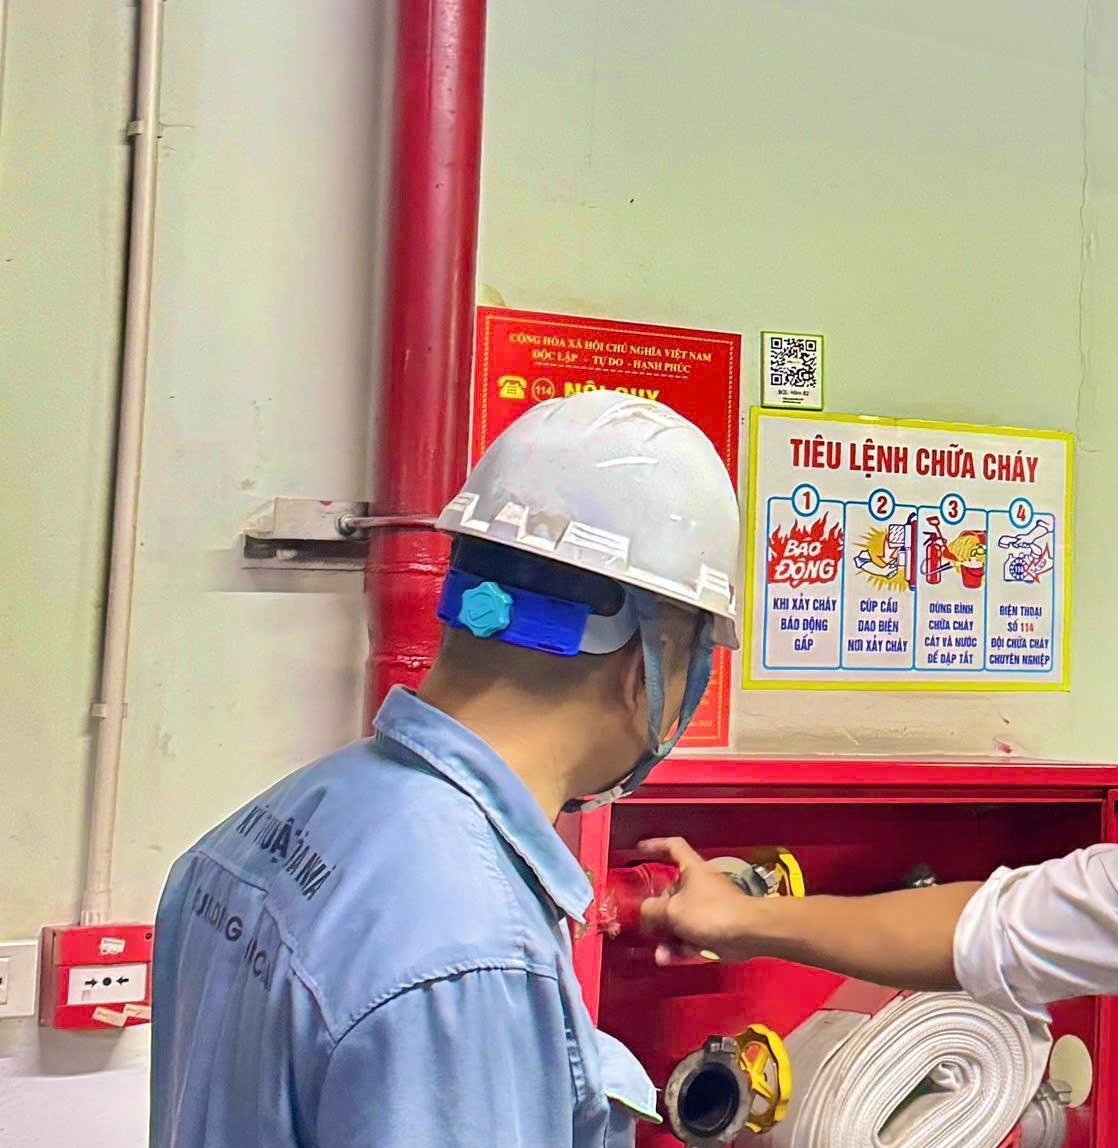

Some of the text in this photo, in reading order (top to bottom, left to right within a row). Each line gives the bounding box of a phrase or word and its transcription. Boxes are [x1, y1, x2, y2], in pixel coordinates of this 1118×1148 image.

[585, 339, 604, 353] HỘI
[664, 346, 689, 360] VIỆT
[689, 350, 712, 362] NAM
[608, 356, 624, 366] DO
[633, 359, 663, 372] HẠNH
[664, 360, 691, 373] PHÚC
[535, 384, 553, 396] 114
[790, 434, 1039, 484] TIÊU LỆNH CHỮA CHÁY
[802, 491, 811, 511] 1
[876, 495, 888, 515] 2
[948, 500, 958, 519] 3
[1016, 504, 1026, 522] 4
[783, 537, 822, 557] BÁO
[774, 557, 835, 582] ĐỘNG
[773, 597, 789, 610] KHI
[812, 597, 837, 611] CHÁY
[860, 597, 878, 612] CÚP
[781, 616, 828, 634] BÁO ĐỘNG
[858, 620, 876, 632] DAO
[953, 619, 974, 632] CHÁY
[794, 633, 814, 651] GẤP
[886, 637, 909, 652] CHÁY
